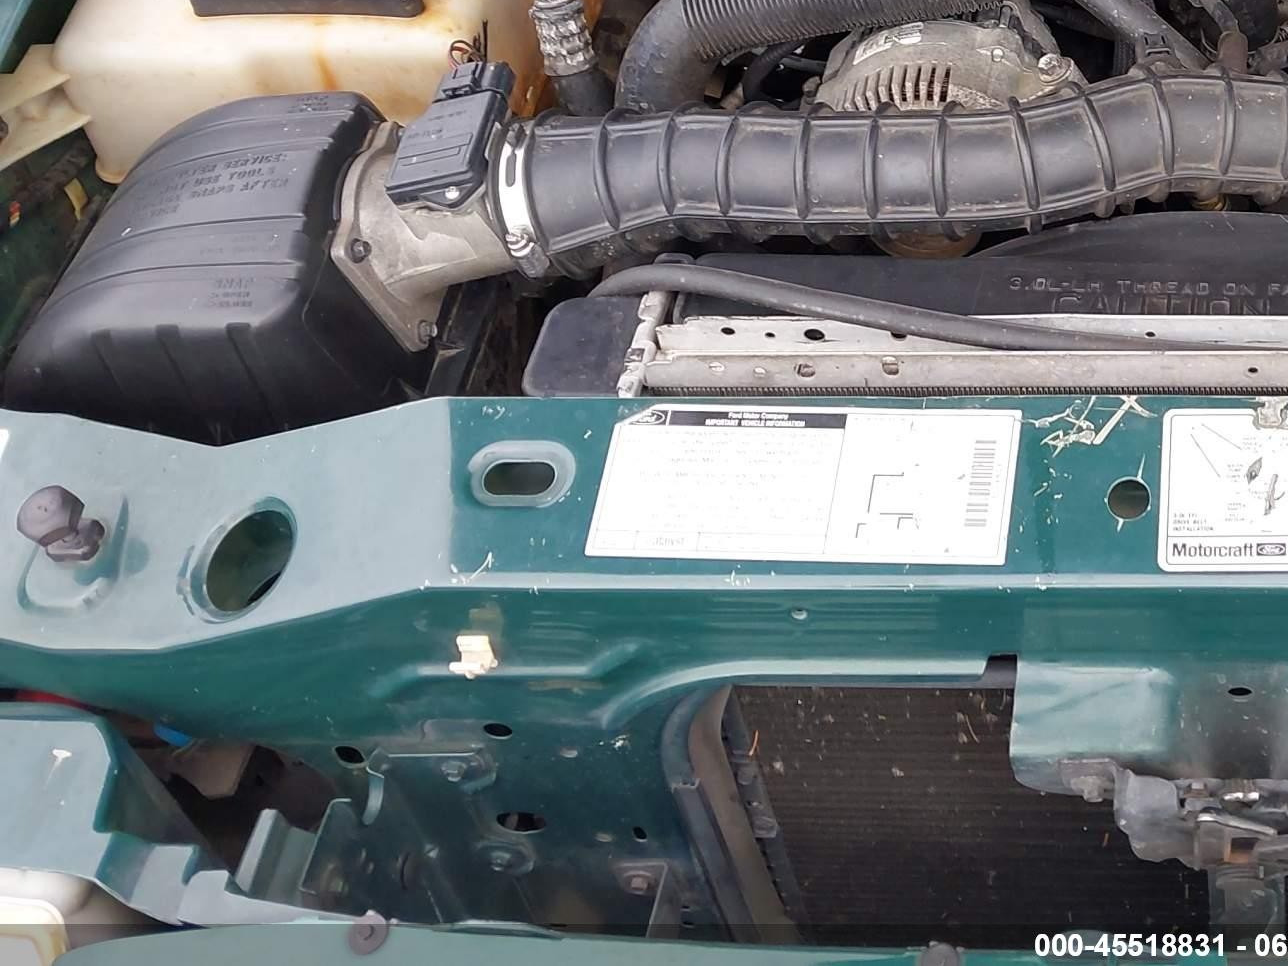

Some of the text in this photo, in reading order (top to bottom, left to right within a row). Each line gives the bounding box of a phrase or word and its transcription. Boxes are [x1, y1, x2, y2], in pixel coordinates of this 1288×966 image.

[1116, 279, 1210, 295] THREAD
[1222, 282, 1255, 296] ON
[1171, 542, 1254, 558] Motorcraft
